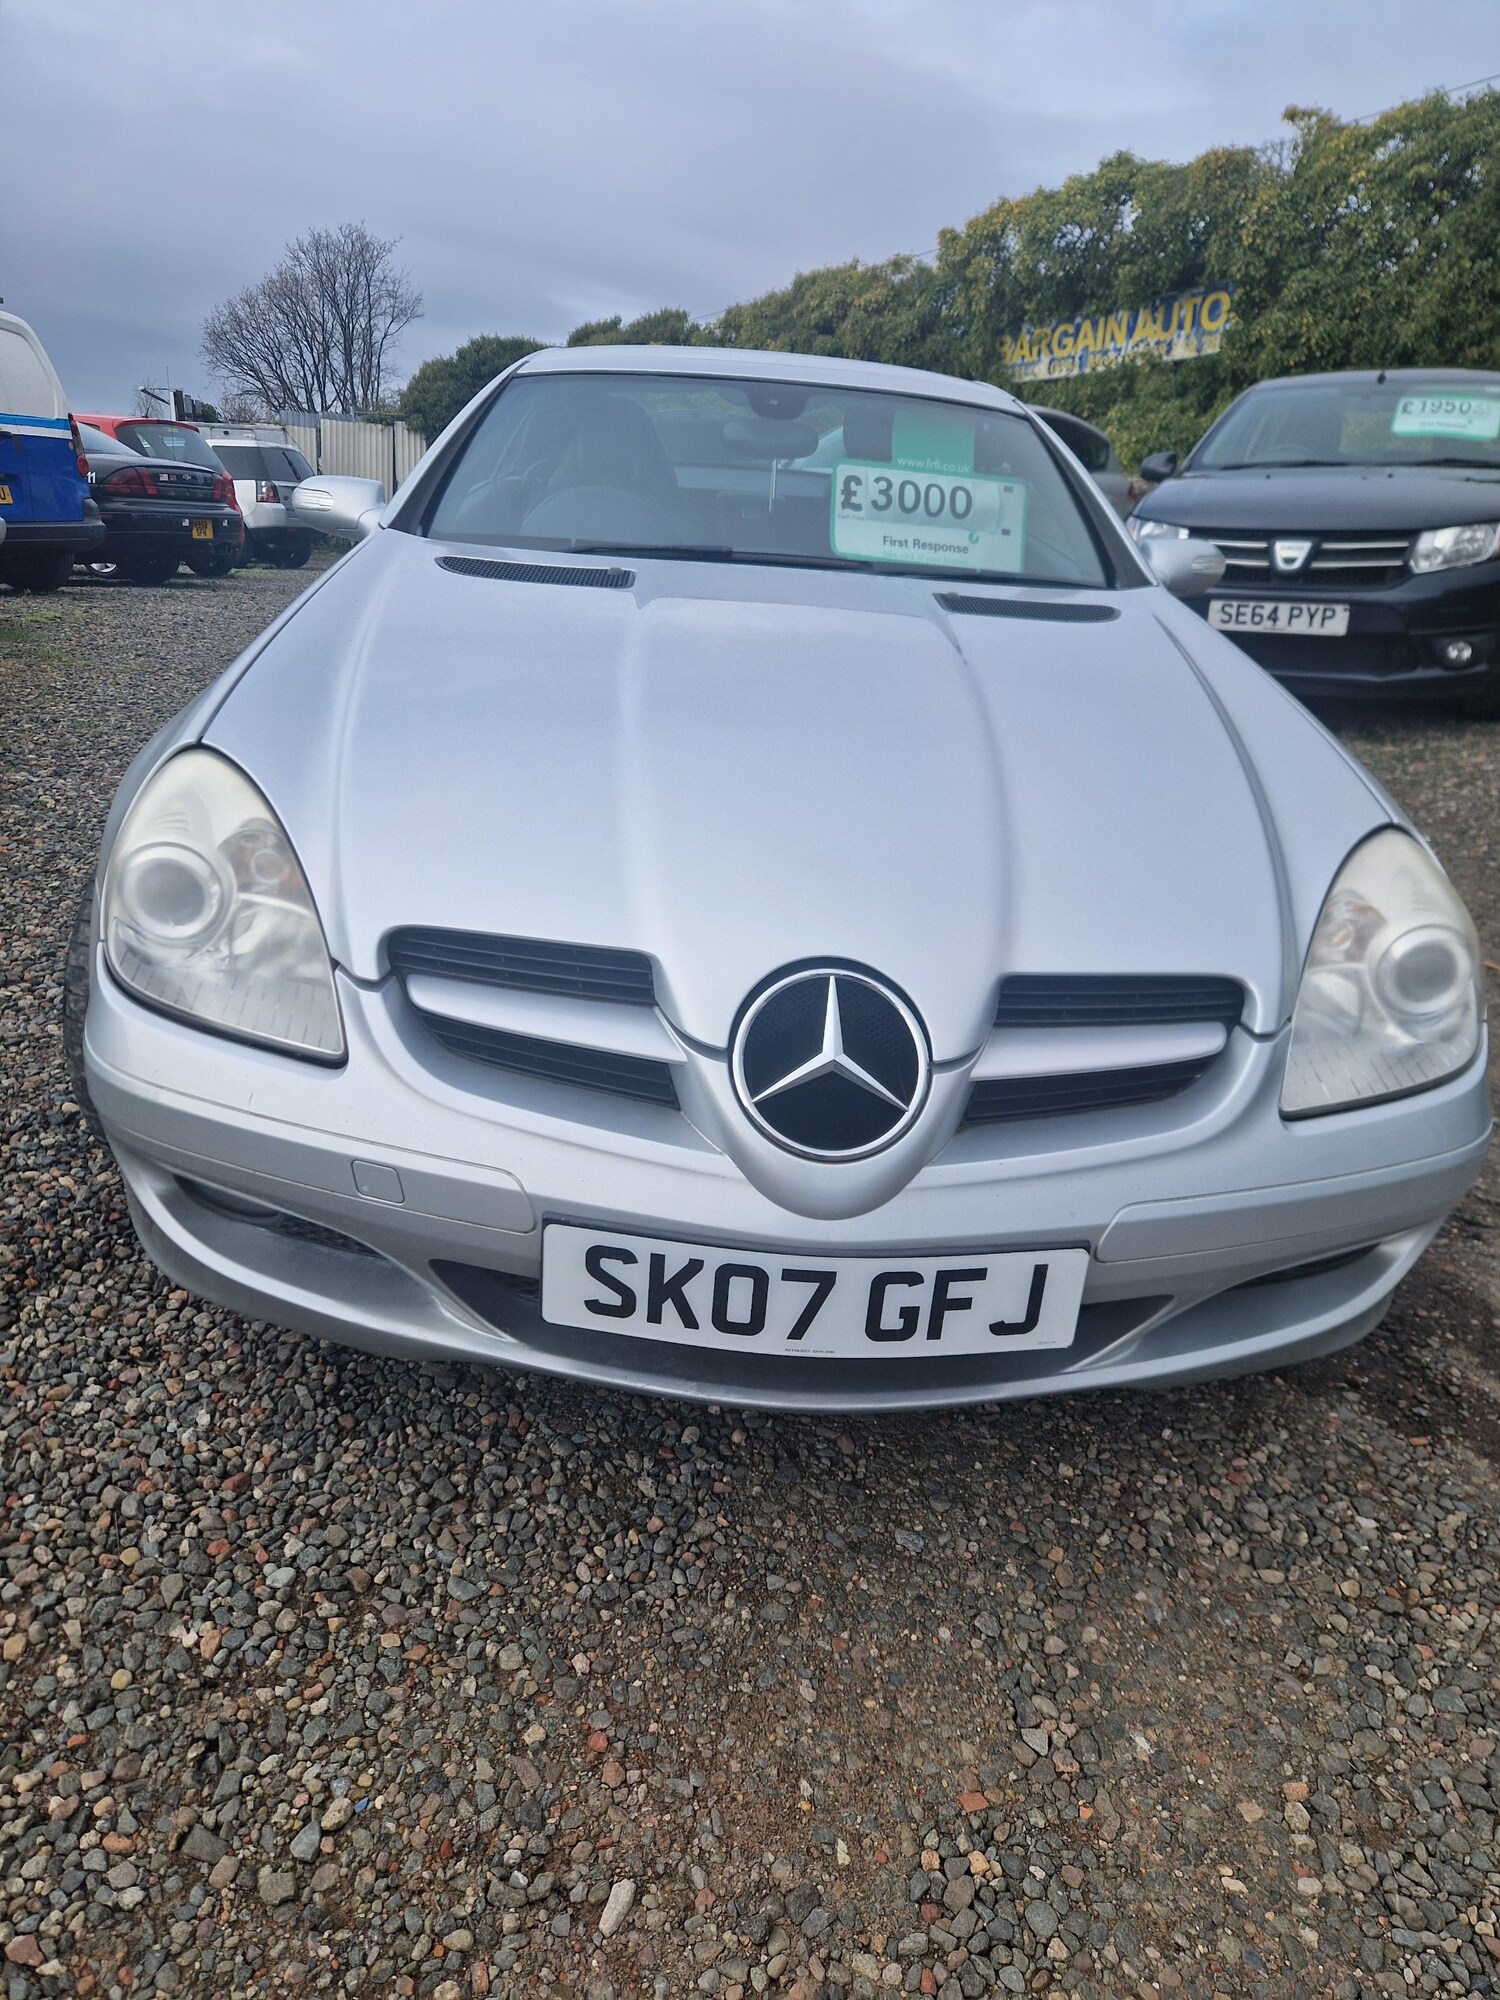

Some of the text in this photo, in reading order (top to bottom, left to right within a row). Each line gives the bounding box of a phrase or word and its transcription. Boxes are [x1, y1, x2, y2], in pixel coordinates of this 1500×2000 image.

[996, 311, 1129, 365] BARGAIN
[1131, 290, 1231, 344] AUTO
[882, 535, 969, 554] First Response
[1219, 603, 1336, 629] SE64 PYP
[583, 1244, 1049, 1343] SK07 GFJ
